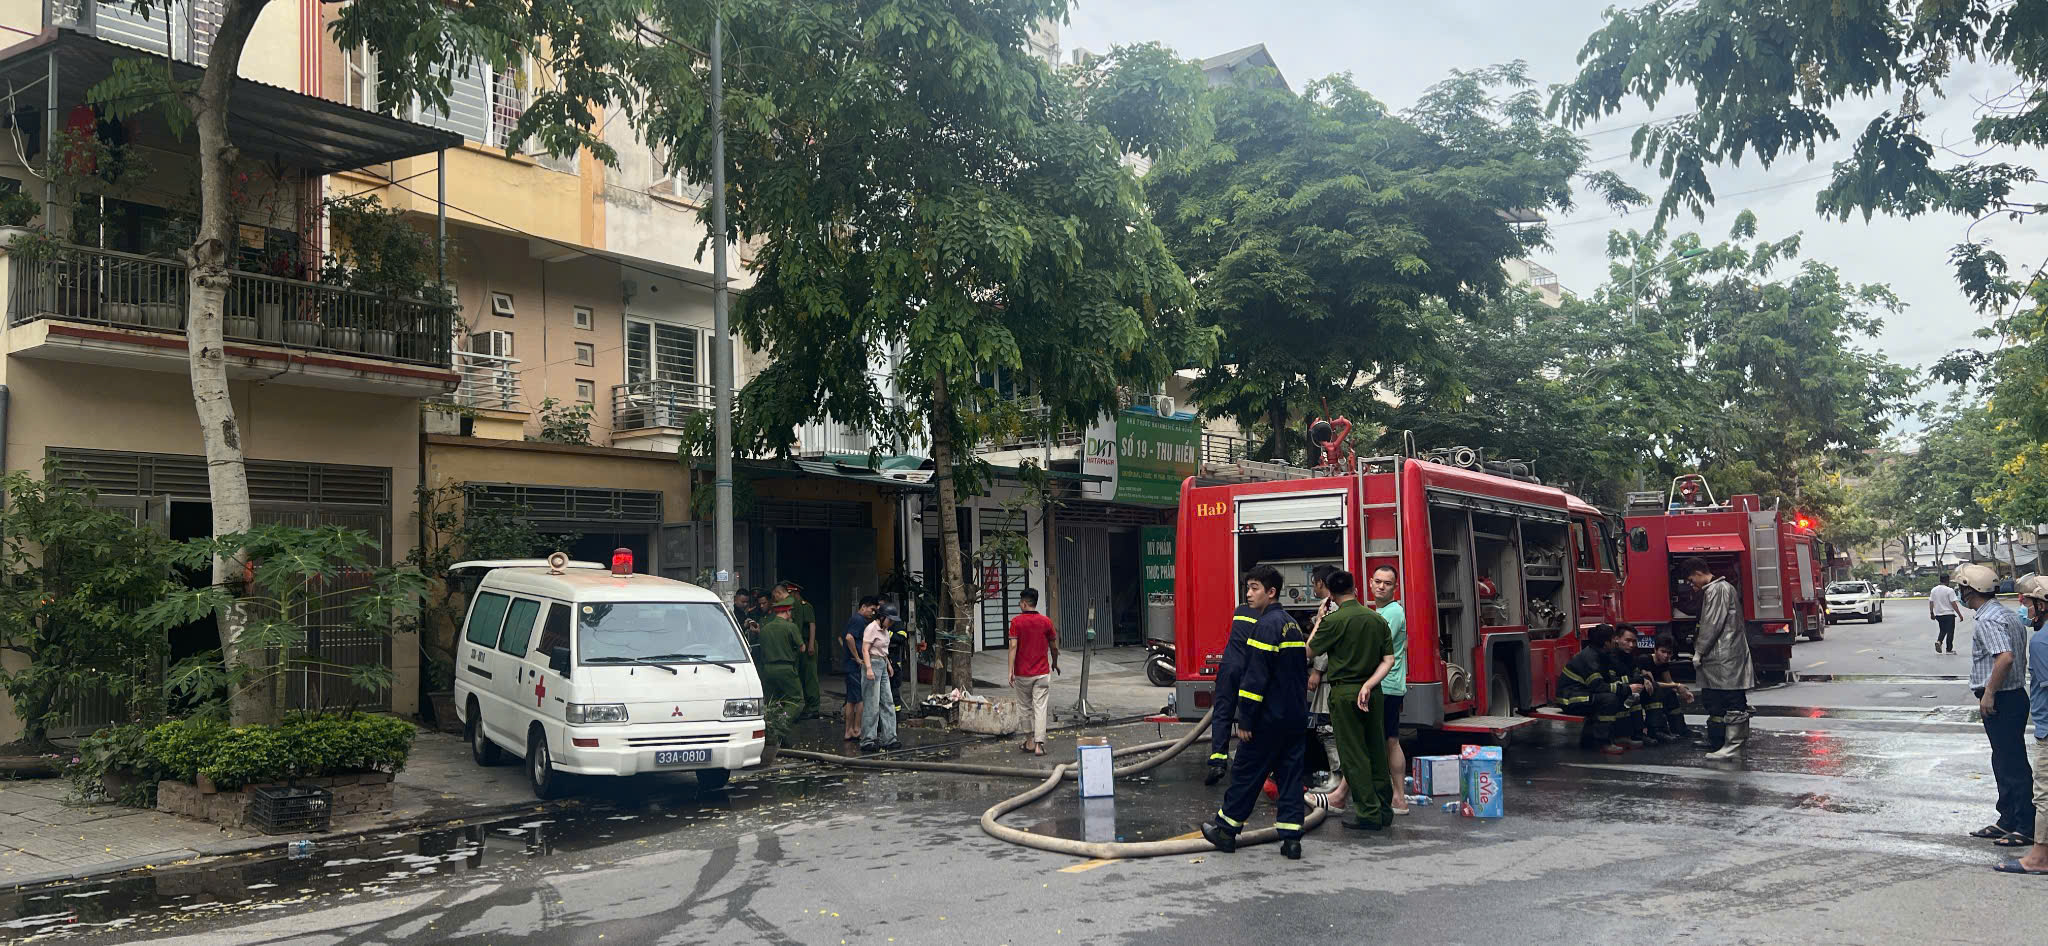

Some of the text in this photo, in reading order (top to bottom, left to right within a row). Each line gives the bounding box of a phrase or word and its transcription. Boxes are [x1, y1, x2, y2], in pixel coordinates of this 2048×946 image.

[1121, 431, 1134, 457] SỐ
[1136, 439, 1147, 459] 19
[1156, 441, 1173, 461] THU
